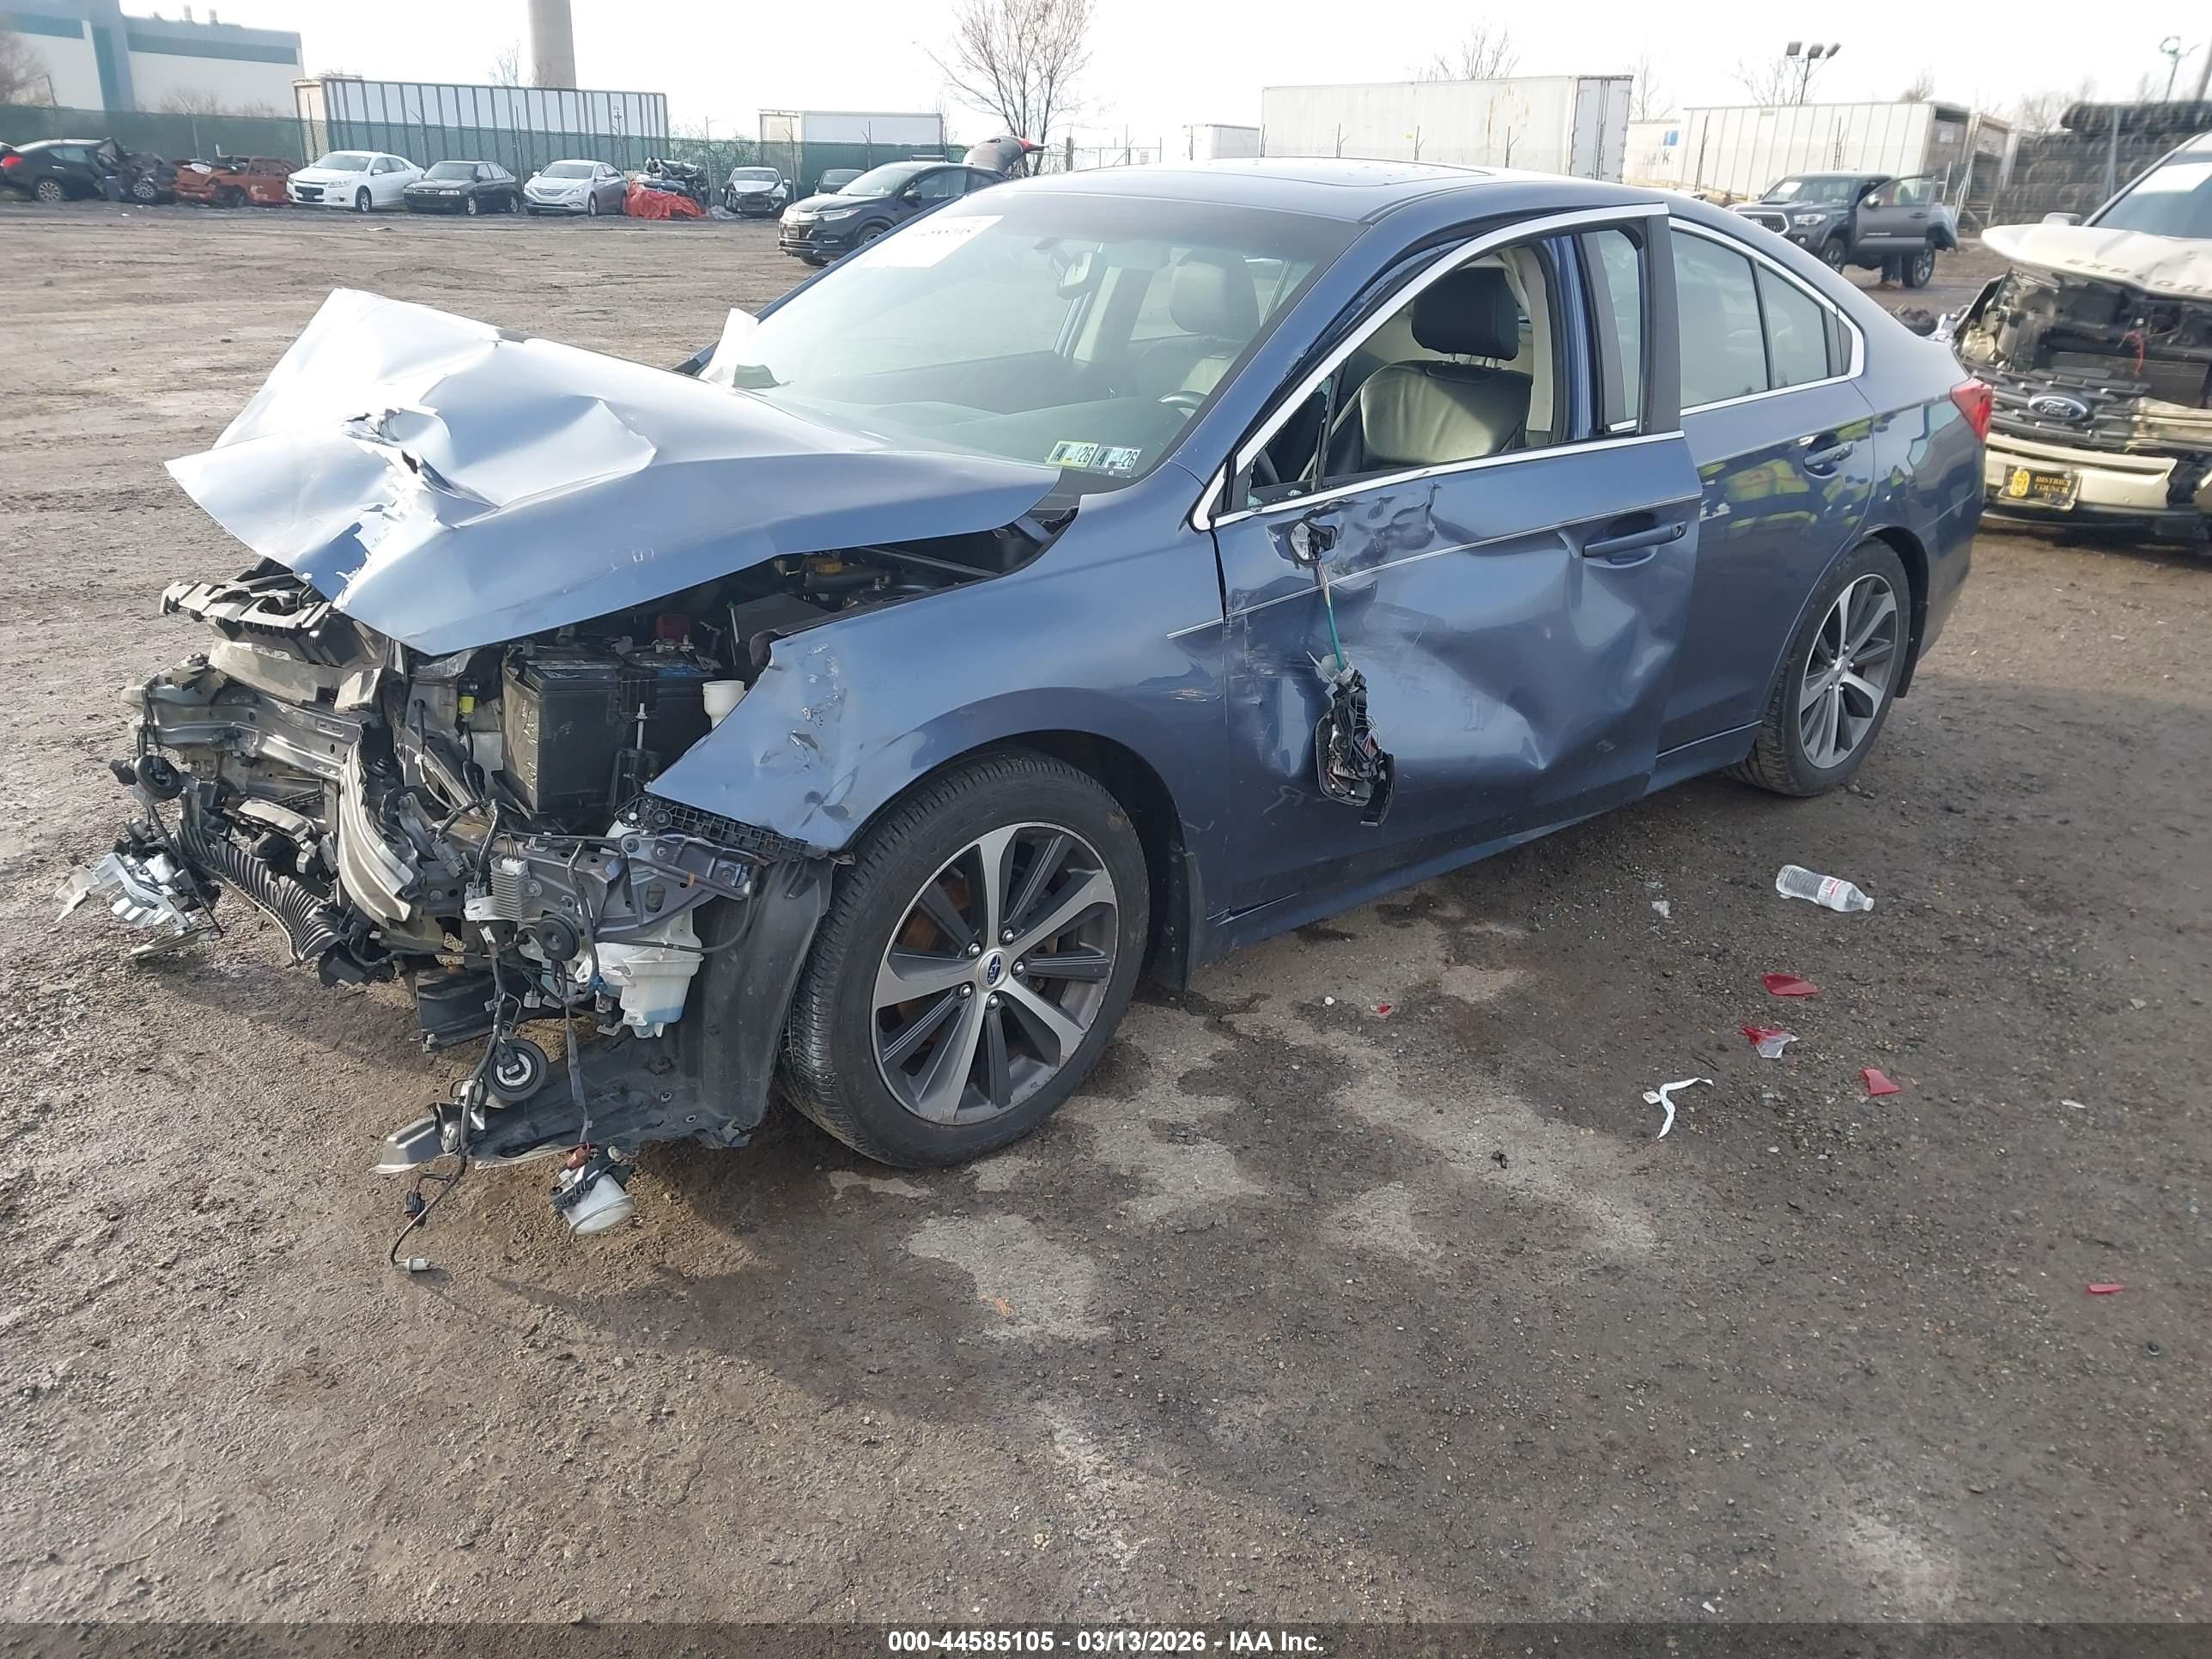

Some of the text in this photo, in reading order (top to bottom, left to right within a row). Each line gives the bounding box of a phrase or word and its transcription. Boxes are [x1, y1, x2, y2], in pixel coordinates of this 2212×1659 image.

[1056, 446, 1095, 463] 4 26
[1098, 450, 1139, 468] 4 26
